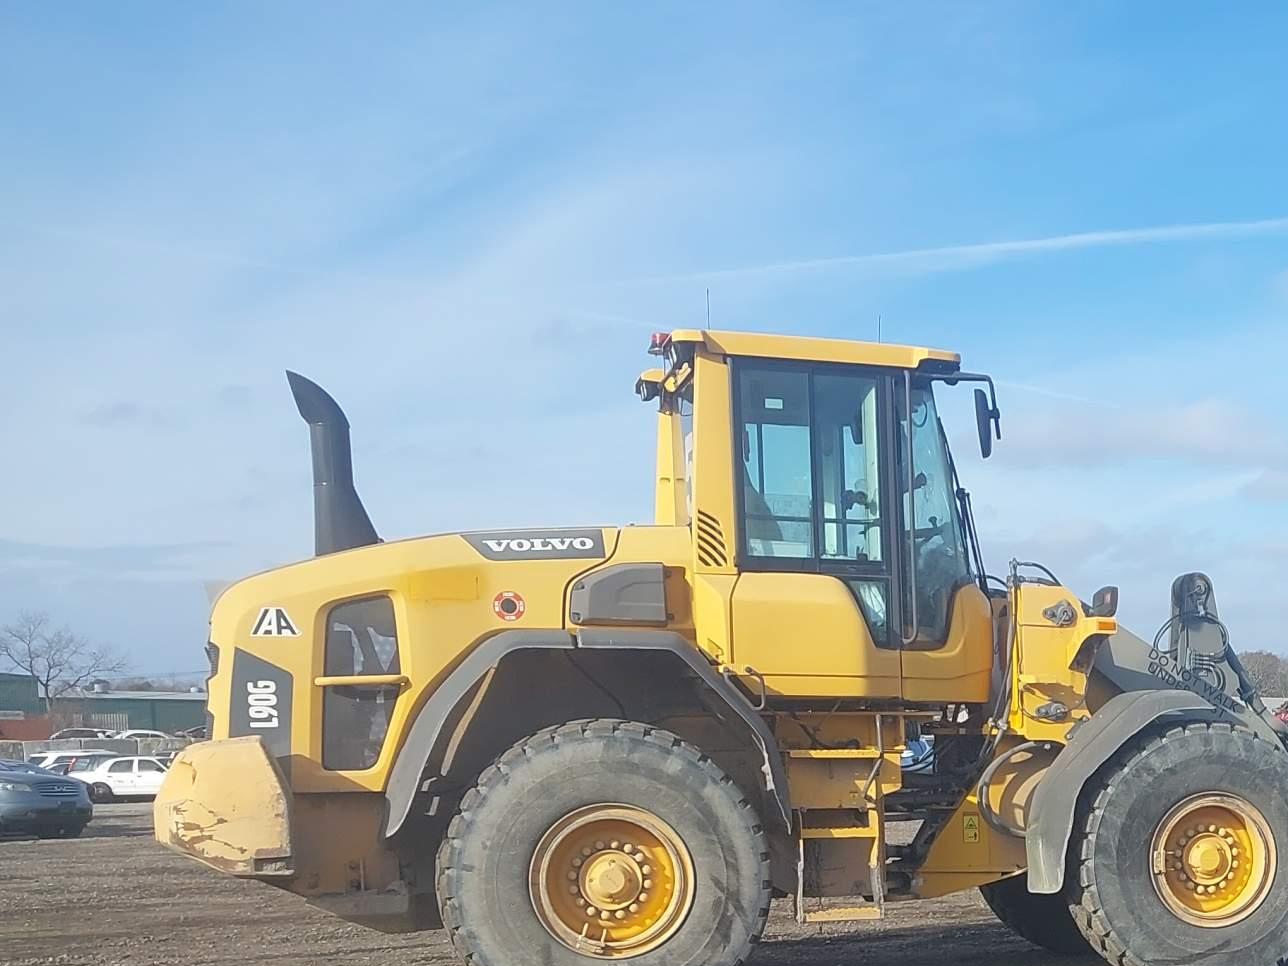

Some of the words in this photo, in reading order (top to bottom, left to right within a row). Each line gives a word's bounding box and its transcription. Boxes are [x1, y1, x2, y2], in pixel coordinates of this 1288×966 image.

[482, 537, 594, 552] VOLVO
[247, 680, 279, 728] L90G
[1148, 648, 1169, 667] DO
[1171, 663, 1202, 687] NOT
[1203, 681, 1239, 713] WALK
